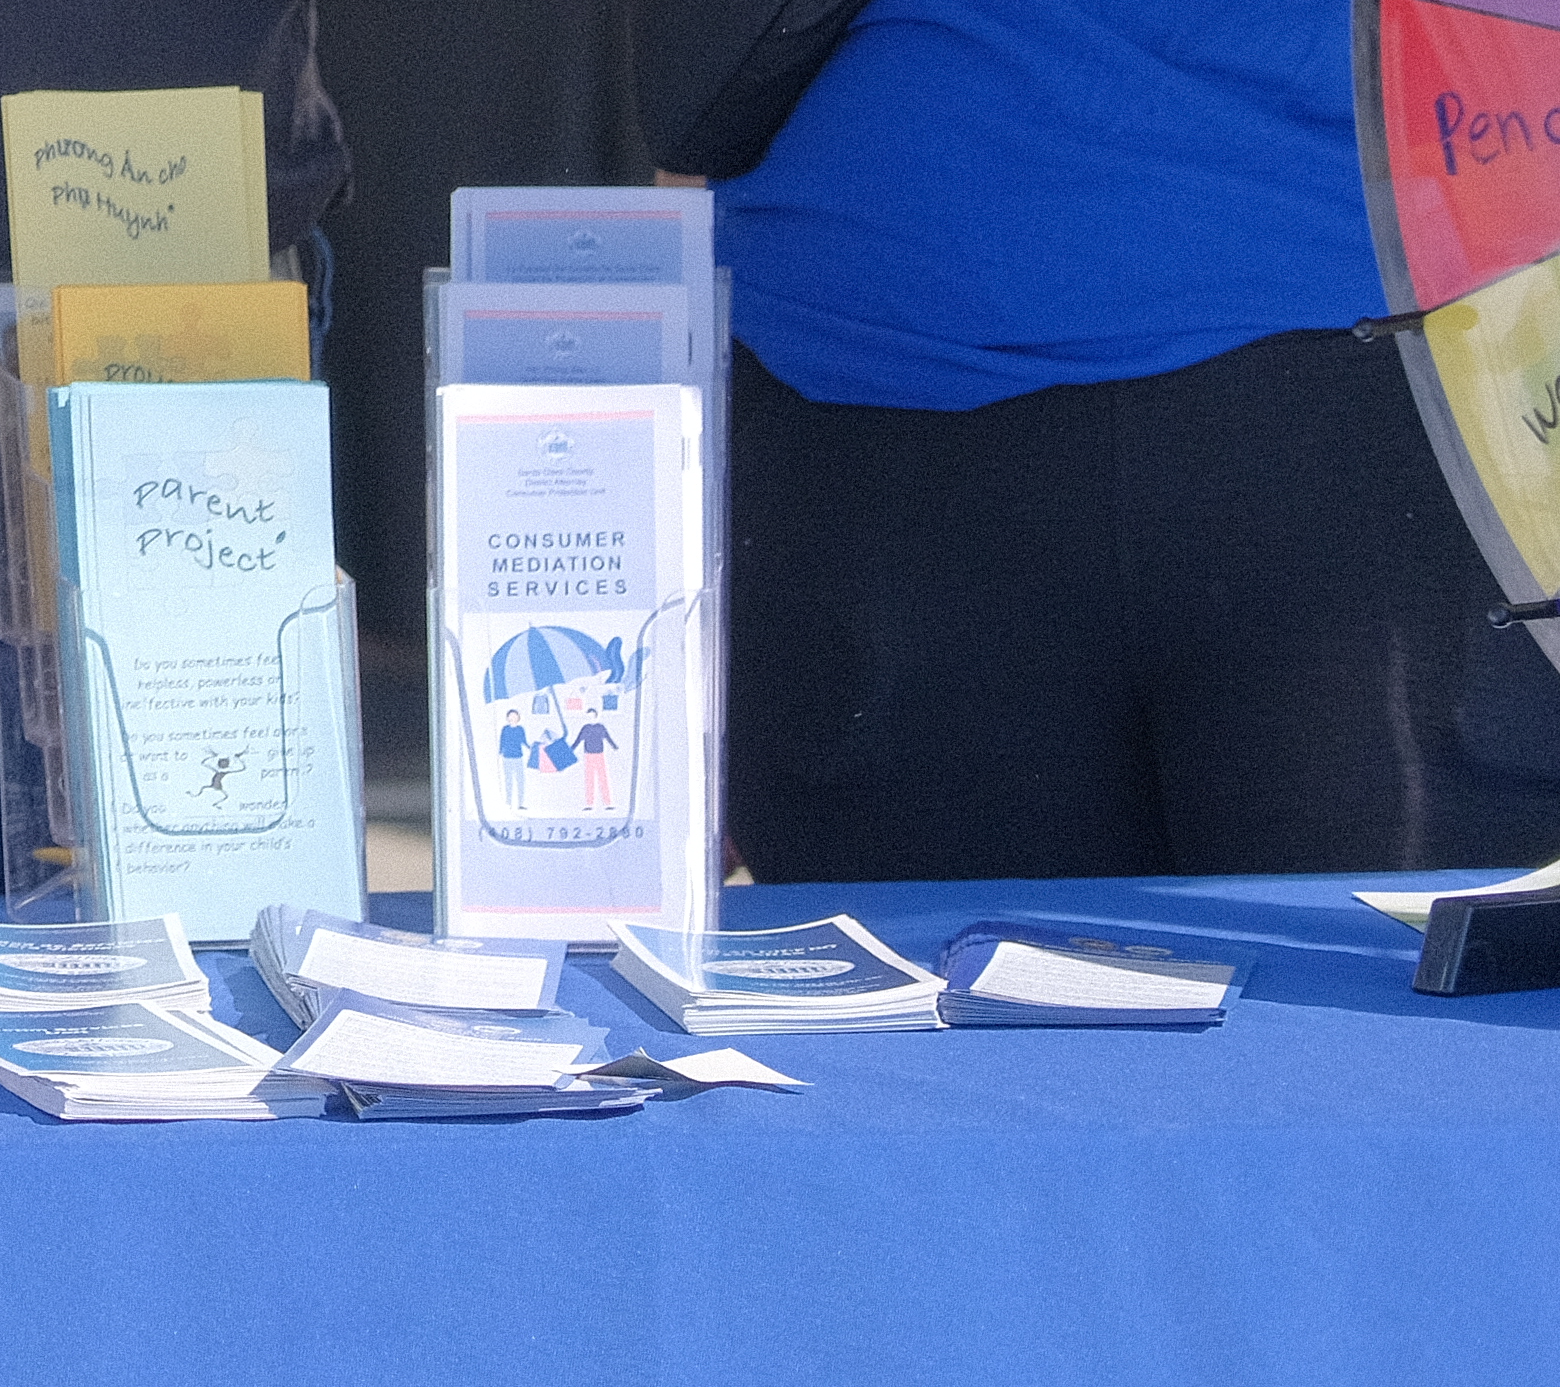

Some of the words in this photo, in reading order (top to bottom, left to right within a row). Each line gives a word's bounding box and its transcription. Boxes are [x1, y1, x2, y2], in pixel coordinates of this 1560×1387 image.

[133, 477, 275, 523] parent
[136, 526, 277, 573] project
[488, 531, 627, 550] CONSUMER
[491, 556, 622, 574] MEDIATION
[487, 580, 629, 598] SERVICES
